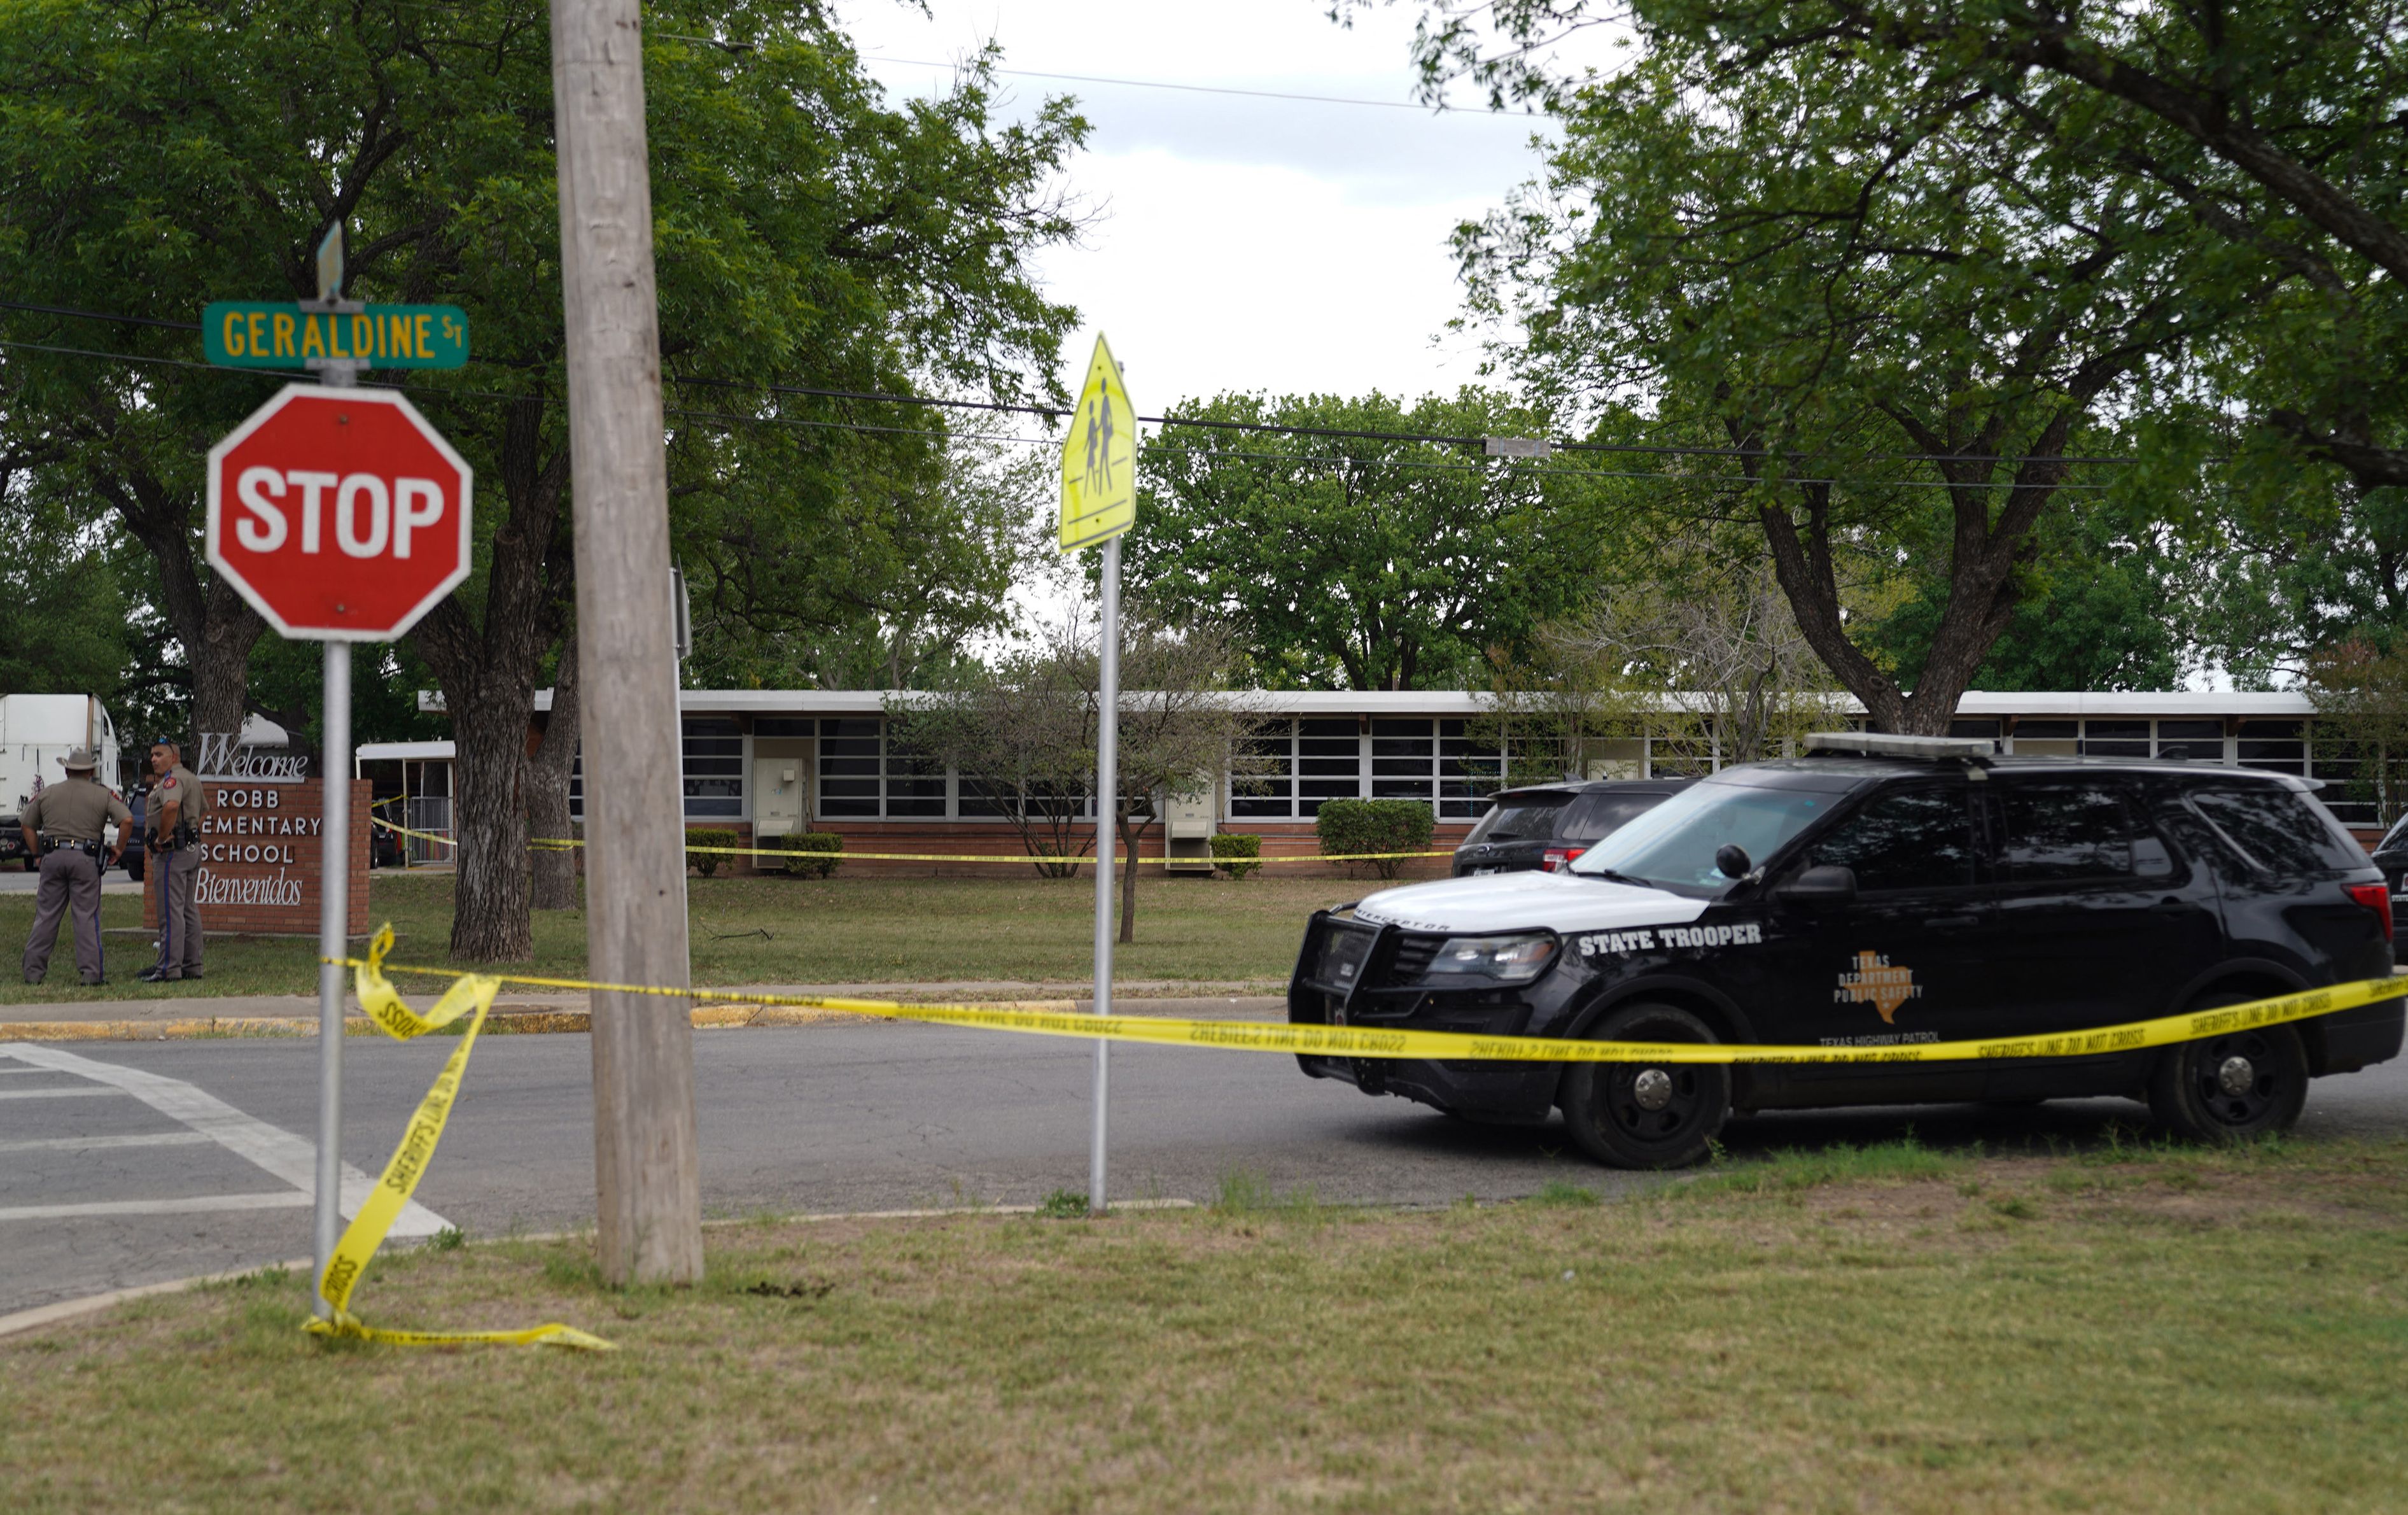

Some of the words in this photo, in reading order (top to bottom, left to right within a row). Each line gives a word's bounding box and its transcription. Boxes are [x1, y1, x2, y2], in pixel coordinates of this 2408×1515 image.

[223, 311, 436, 358] GERALDINE
[442, 315, 463, 348] ST
[235, 465, 445, 560] STOP
[197, 732, 309, 779] Welcome
[217, 789, 280, 809] ROBB
[202, 815, 322, 836] EMENTARY
[200, 843, 294, 864] SCHOOL
[194, 866, 304, 905] Bienvenidos
[1579, 930, 1655, 956] STATE
[1658, 924, 1762, 948] TROOPER
[1852, 954, 1890, 970] TEXAS
[1838, 969, 1914, 987] DEPARTMENT
[1833, 987, 1878, 1003] PUBLIC
[1880, 984, 1924, 1001] SAFETY
[1819, 1036, 1853, 1047] TEXAS
[1854, 1032, 1901, 1046] HIGHWAY
[1902, 1031, 1941, 1043] PATROL
